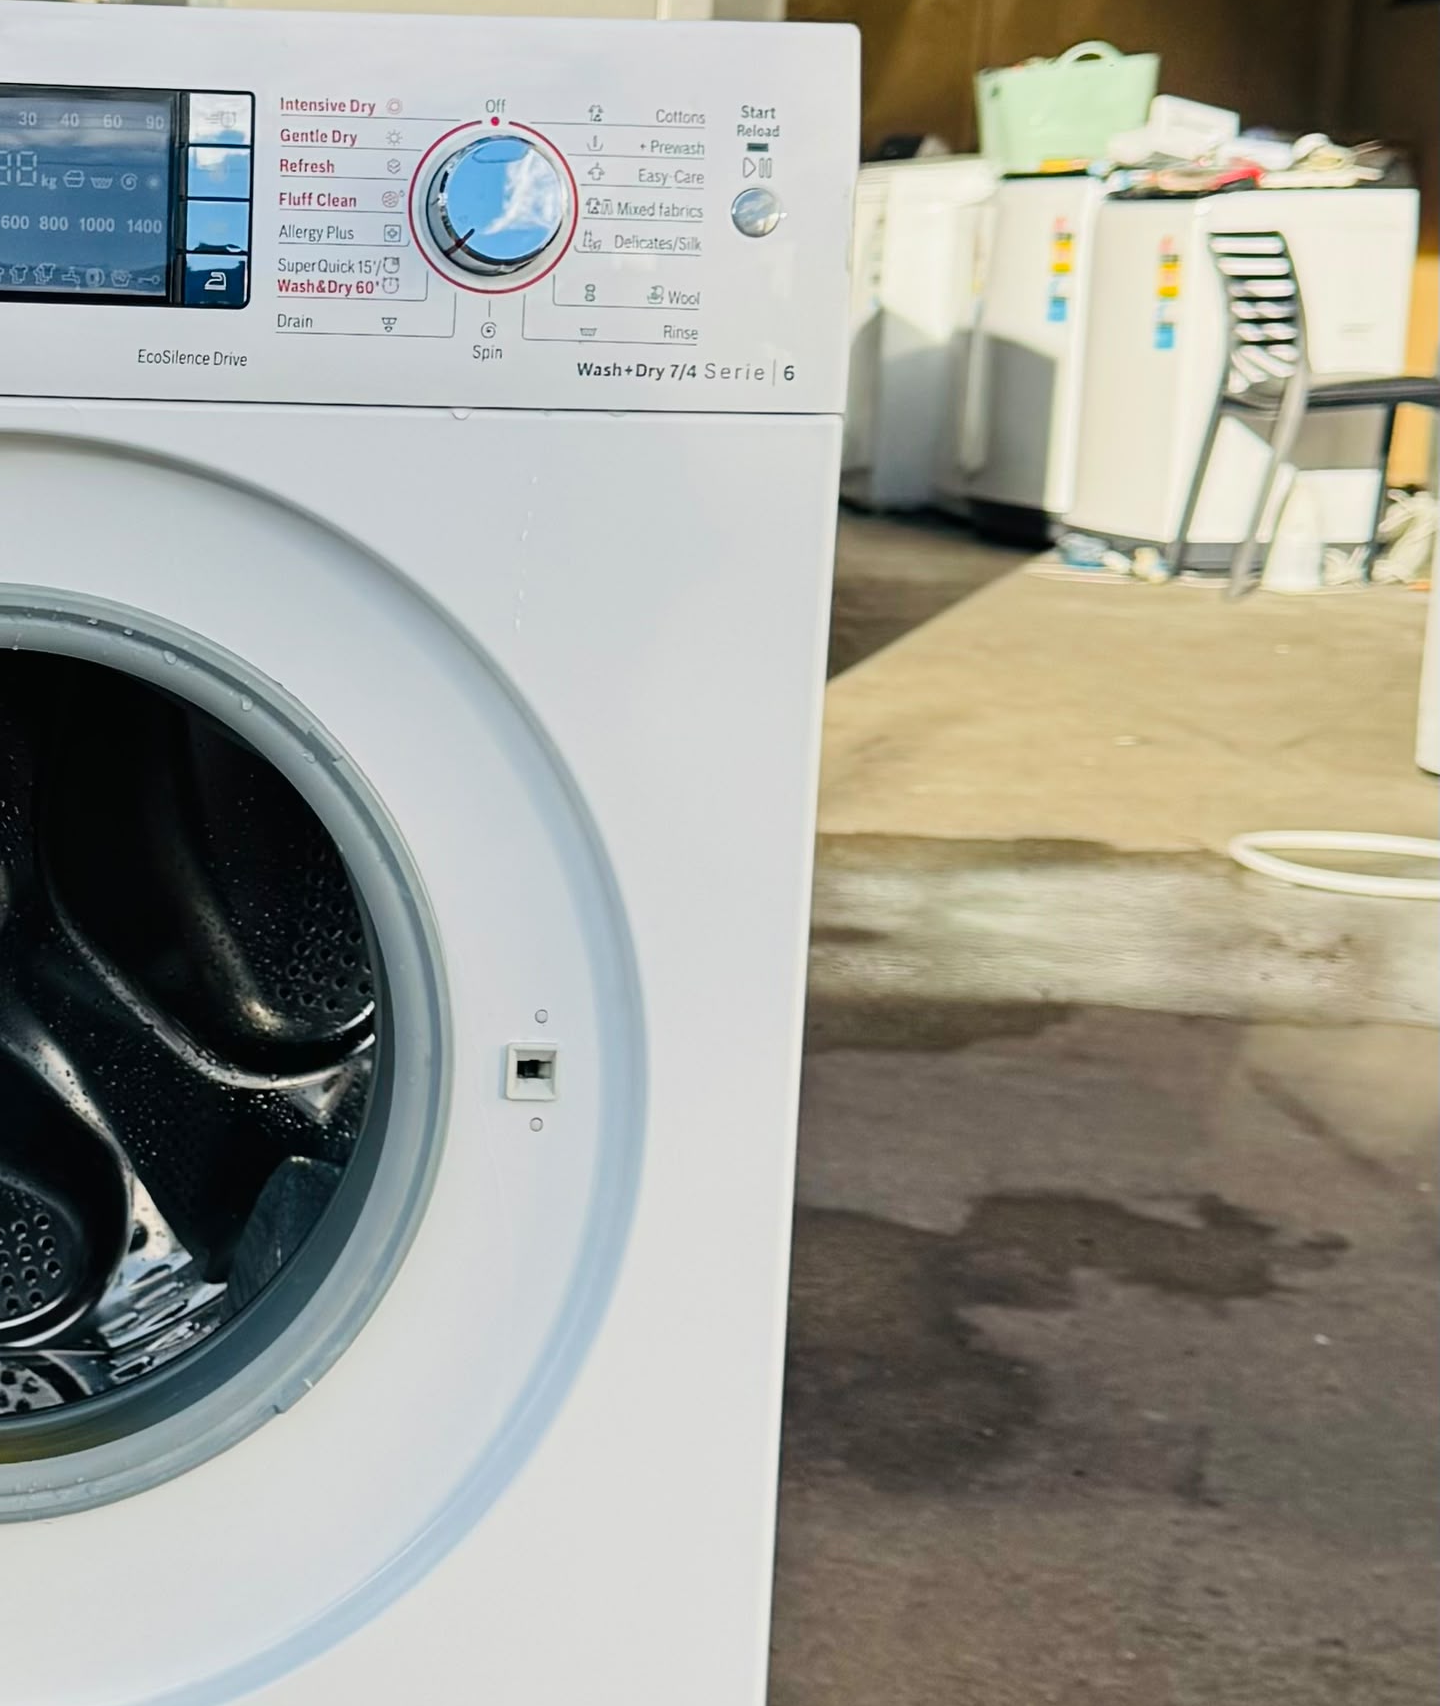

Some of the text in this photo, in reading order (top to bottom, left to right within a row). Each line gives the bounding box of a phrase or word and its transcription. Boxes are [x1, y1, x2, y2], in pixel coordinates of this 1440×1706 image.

[279, 97, 376, 116] Intensive Dry
[485, 98, 507, 113] Off
[740, 105, 777, 120] Start
[18, 111, 37, 126] 30
[60, 113, 80, 128] 40
[103, 114, 123, 129] 60
[146, 115, 165, 130] 90
[655, 108, 706, 124] Cottons
[279, 128, 357, 147] Gentle Dry
[736, 124, 780, 138] Reload
[650, 139, 705, 155] Prewash
[279, 158, 335, 173] Refresh
[41, 174, 58, 190] kg
[279, 192, 357, 208] Fluff Clean
[617, 201, 704, 218] Mixed fabrics
[0, 214, 30, 230] 600
[39, 216, 69, 231] 800
[79, 217, 116, 232] 1000
[126, 219, 163, 234] 1400
[278, 224, 355, 242] Allergy Plus
[614, 234, 702, 251] Delicates/Silk
[277, 279, 352, 297] Wash&Dry
[667, 290, 700, 305] Wool
[277, 313, 313, 329] Drain
[663, 324, 699, 340] Rinse
[137, 348, 248, 367] EcoSilence Drive
[472, 344, 503, 361] Spin
[577, 362, 795, 381] Wash+Dry 7/4 Serie 6
